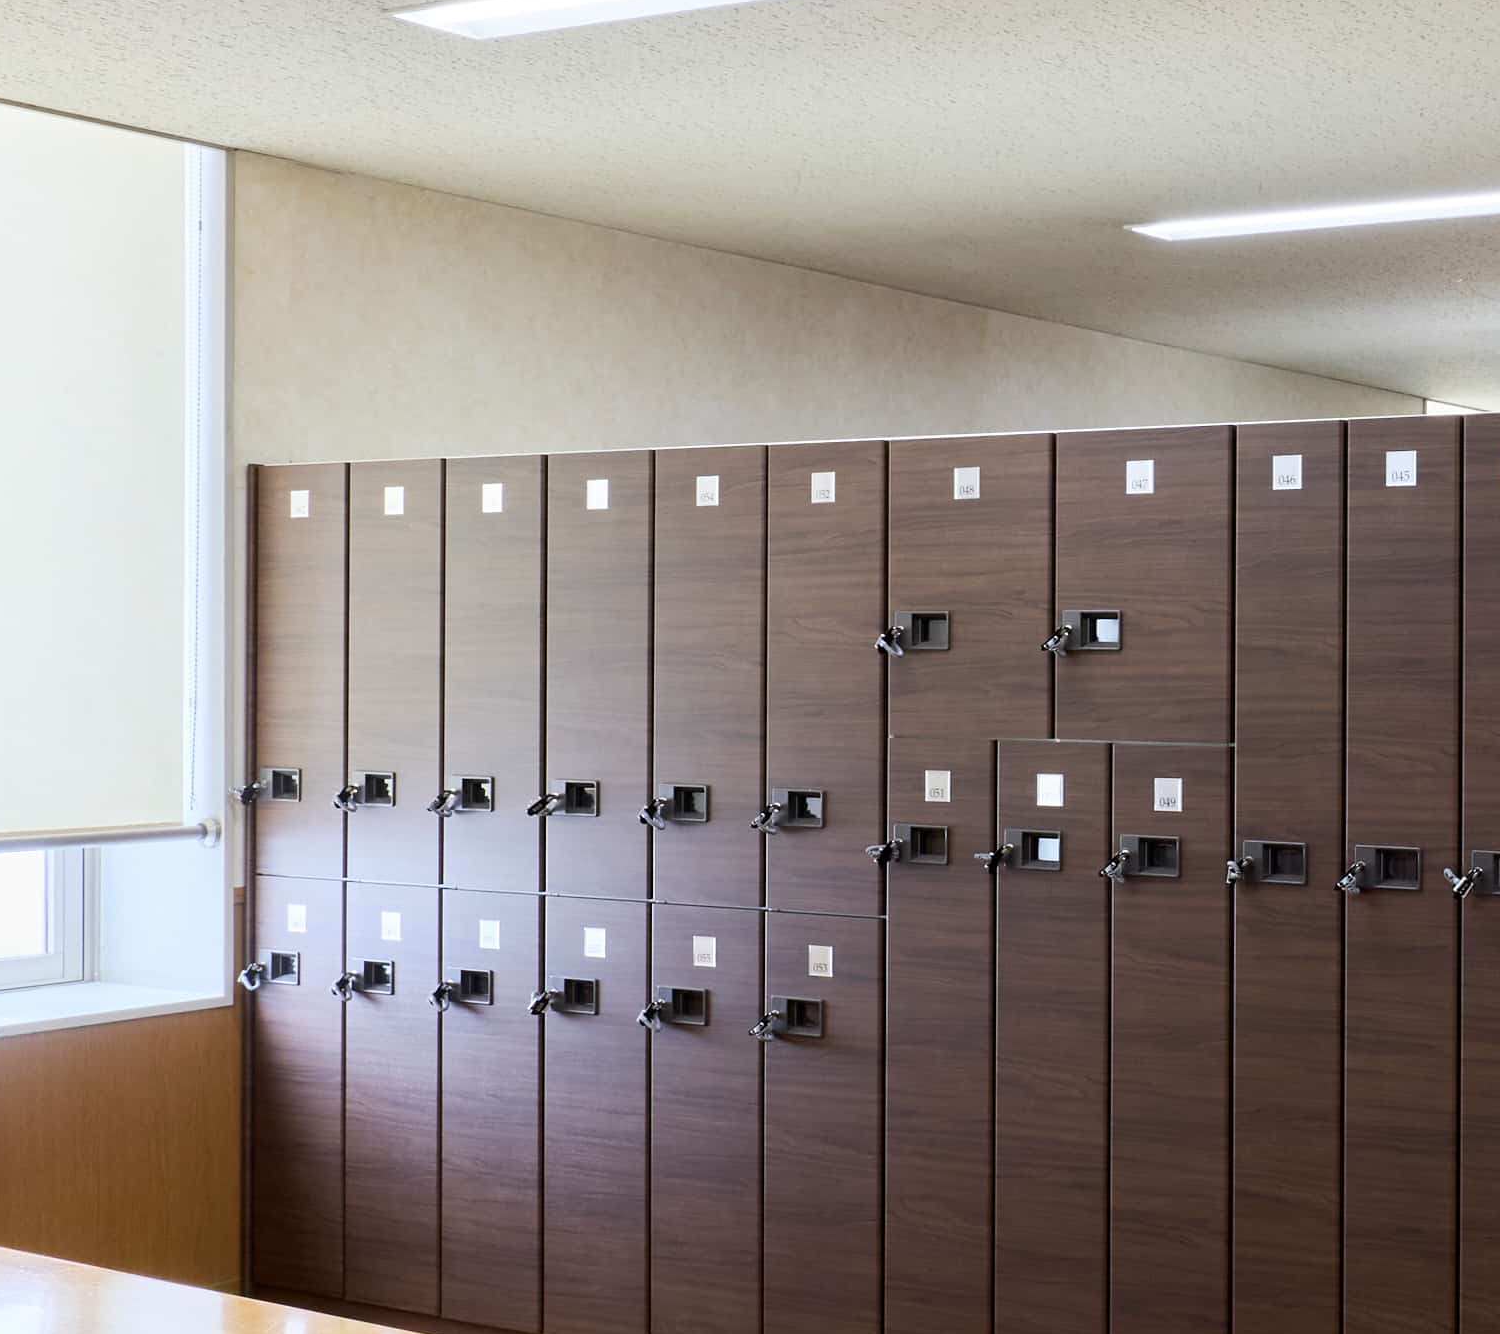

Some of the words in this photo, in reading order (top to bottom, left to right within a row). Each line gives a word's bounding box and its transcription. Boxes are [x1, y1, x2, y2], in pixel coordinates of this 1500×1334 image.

[1278, 474, 1296, 486] 046
[1391, 470, 1410, 482] 045
[1132, 479, 1149, 491] 047
[1159, 796, 1176, 807] 049
